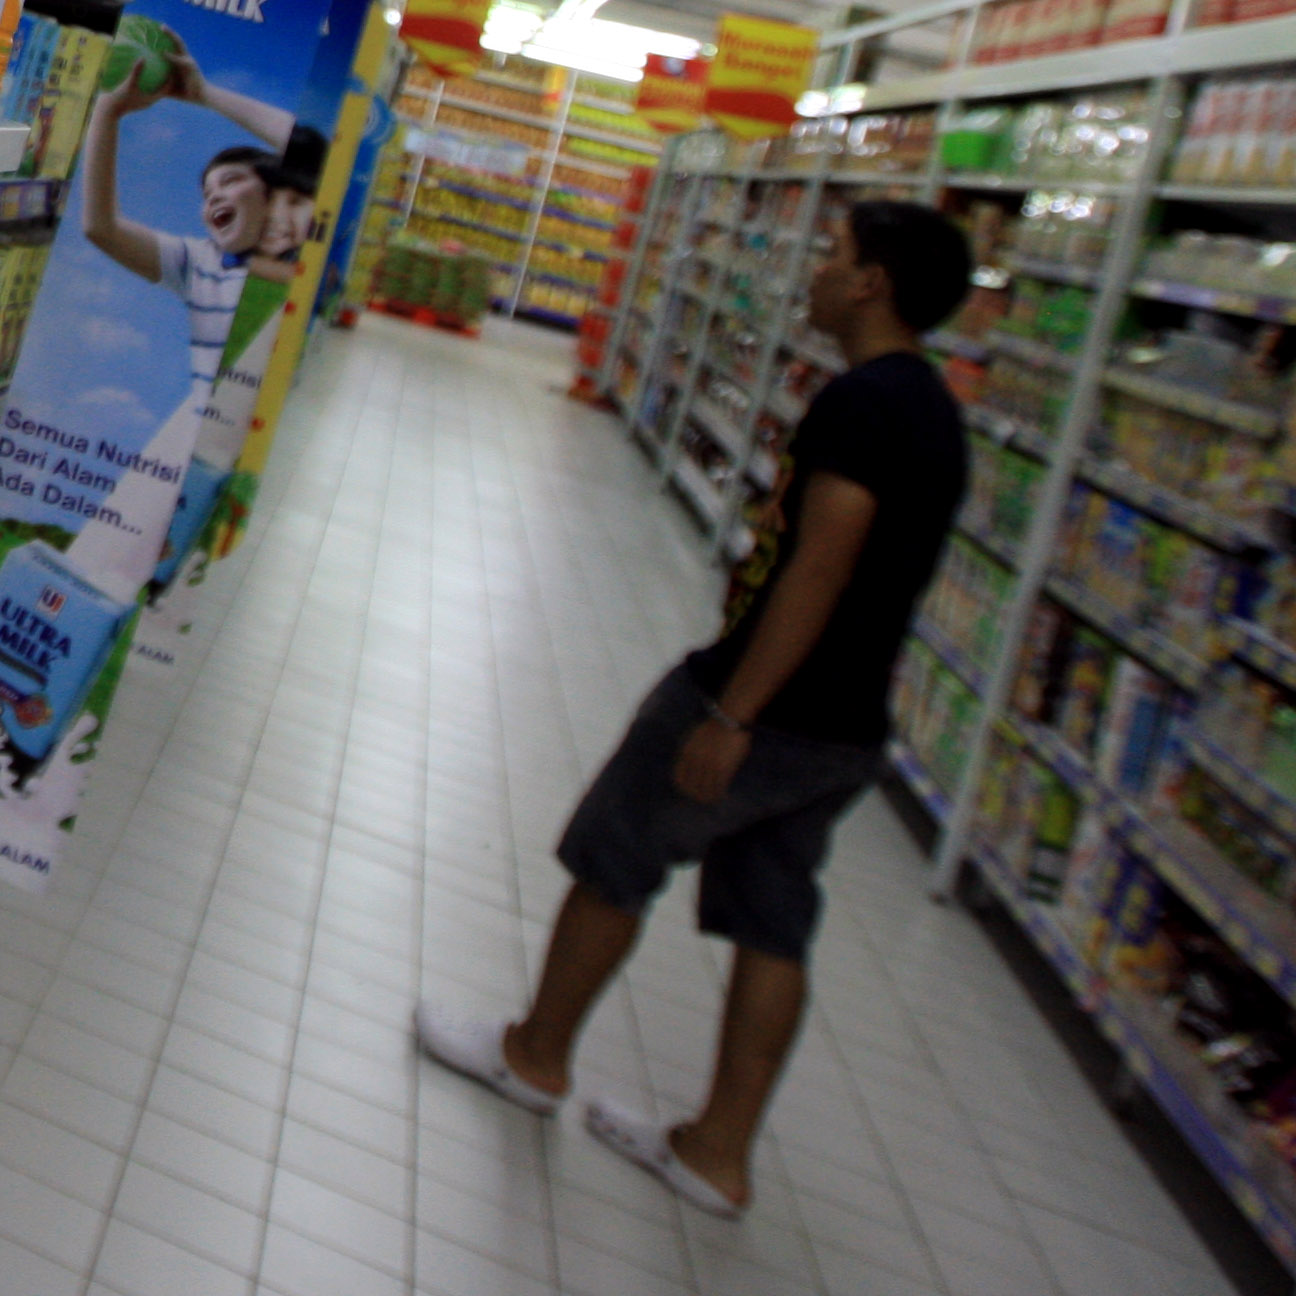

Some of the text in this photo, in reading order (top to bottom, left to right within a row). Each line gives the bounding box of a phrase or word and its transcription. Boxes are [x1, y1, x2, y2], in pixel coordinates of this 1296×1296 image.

[5, 409, 182, 485] Semua Nutrisi
[53, 458, 117, 494] Alam
[0, 598, 71, 657] ULTRA
[0, 844, 51, 875] ALAM
